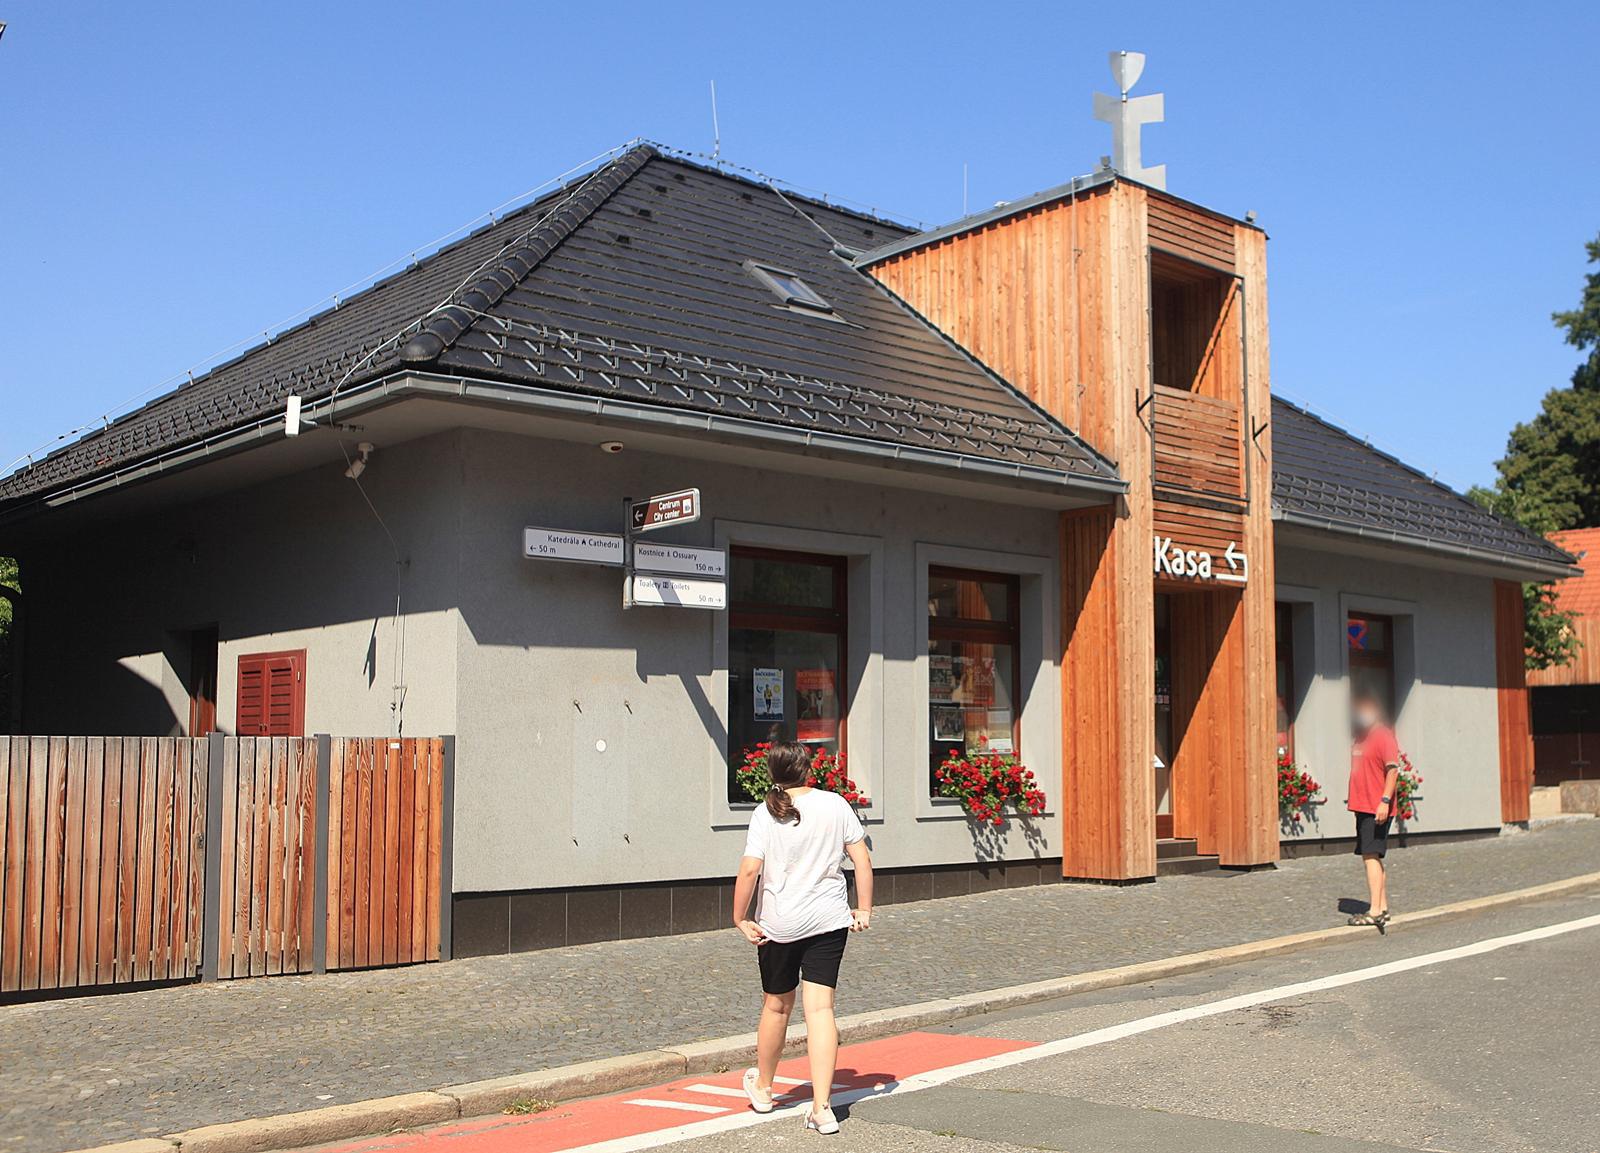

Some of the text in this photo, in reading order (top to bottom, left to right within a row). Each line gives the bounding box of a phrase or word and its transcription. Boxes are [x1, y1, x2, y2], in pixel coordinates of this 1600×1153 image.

[658, 500, 680, 511] Centrum
[653, 509, 680, 522] City center
[547, 534, 620, 549] Katedrála Cathedral
[538, 544, 548, 553] 50
[638, 547, 698, 561] Kostnice Ossuary
[1154, 535, 1212, 578] Kasa
[695, 563, 707, 571] 150
[639, 579, 691, 590] Toalety Toilets
